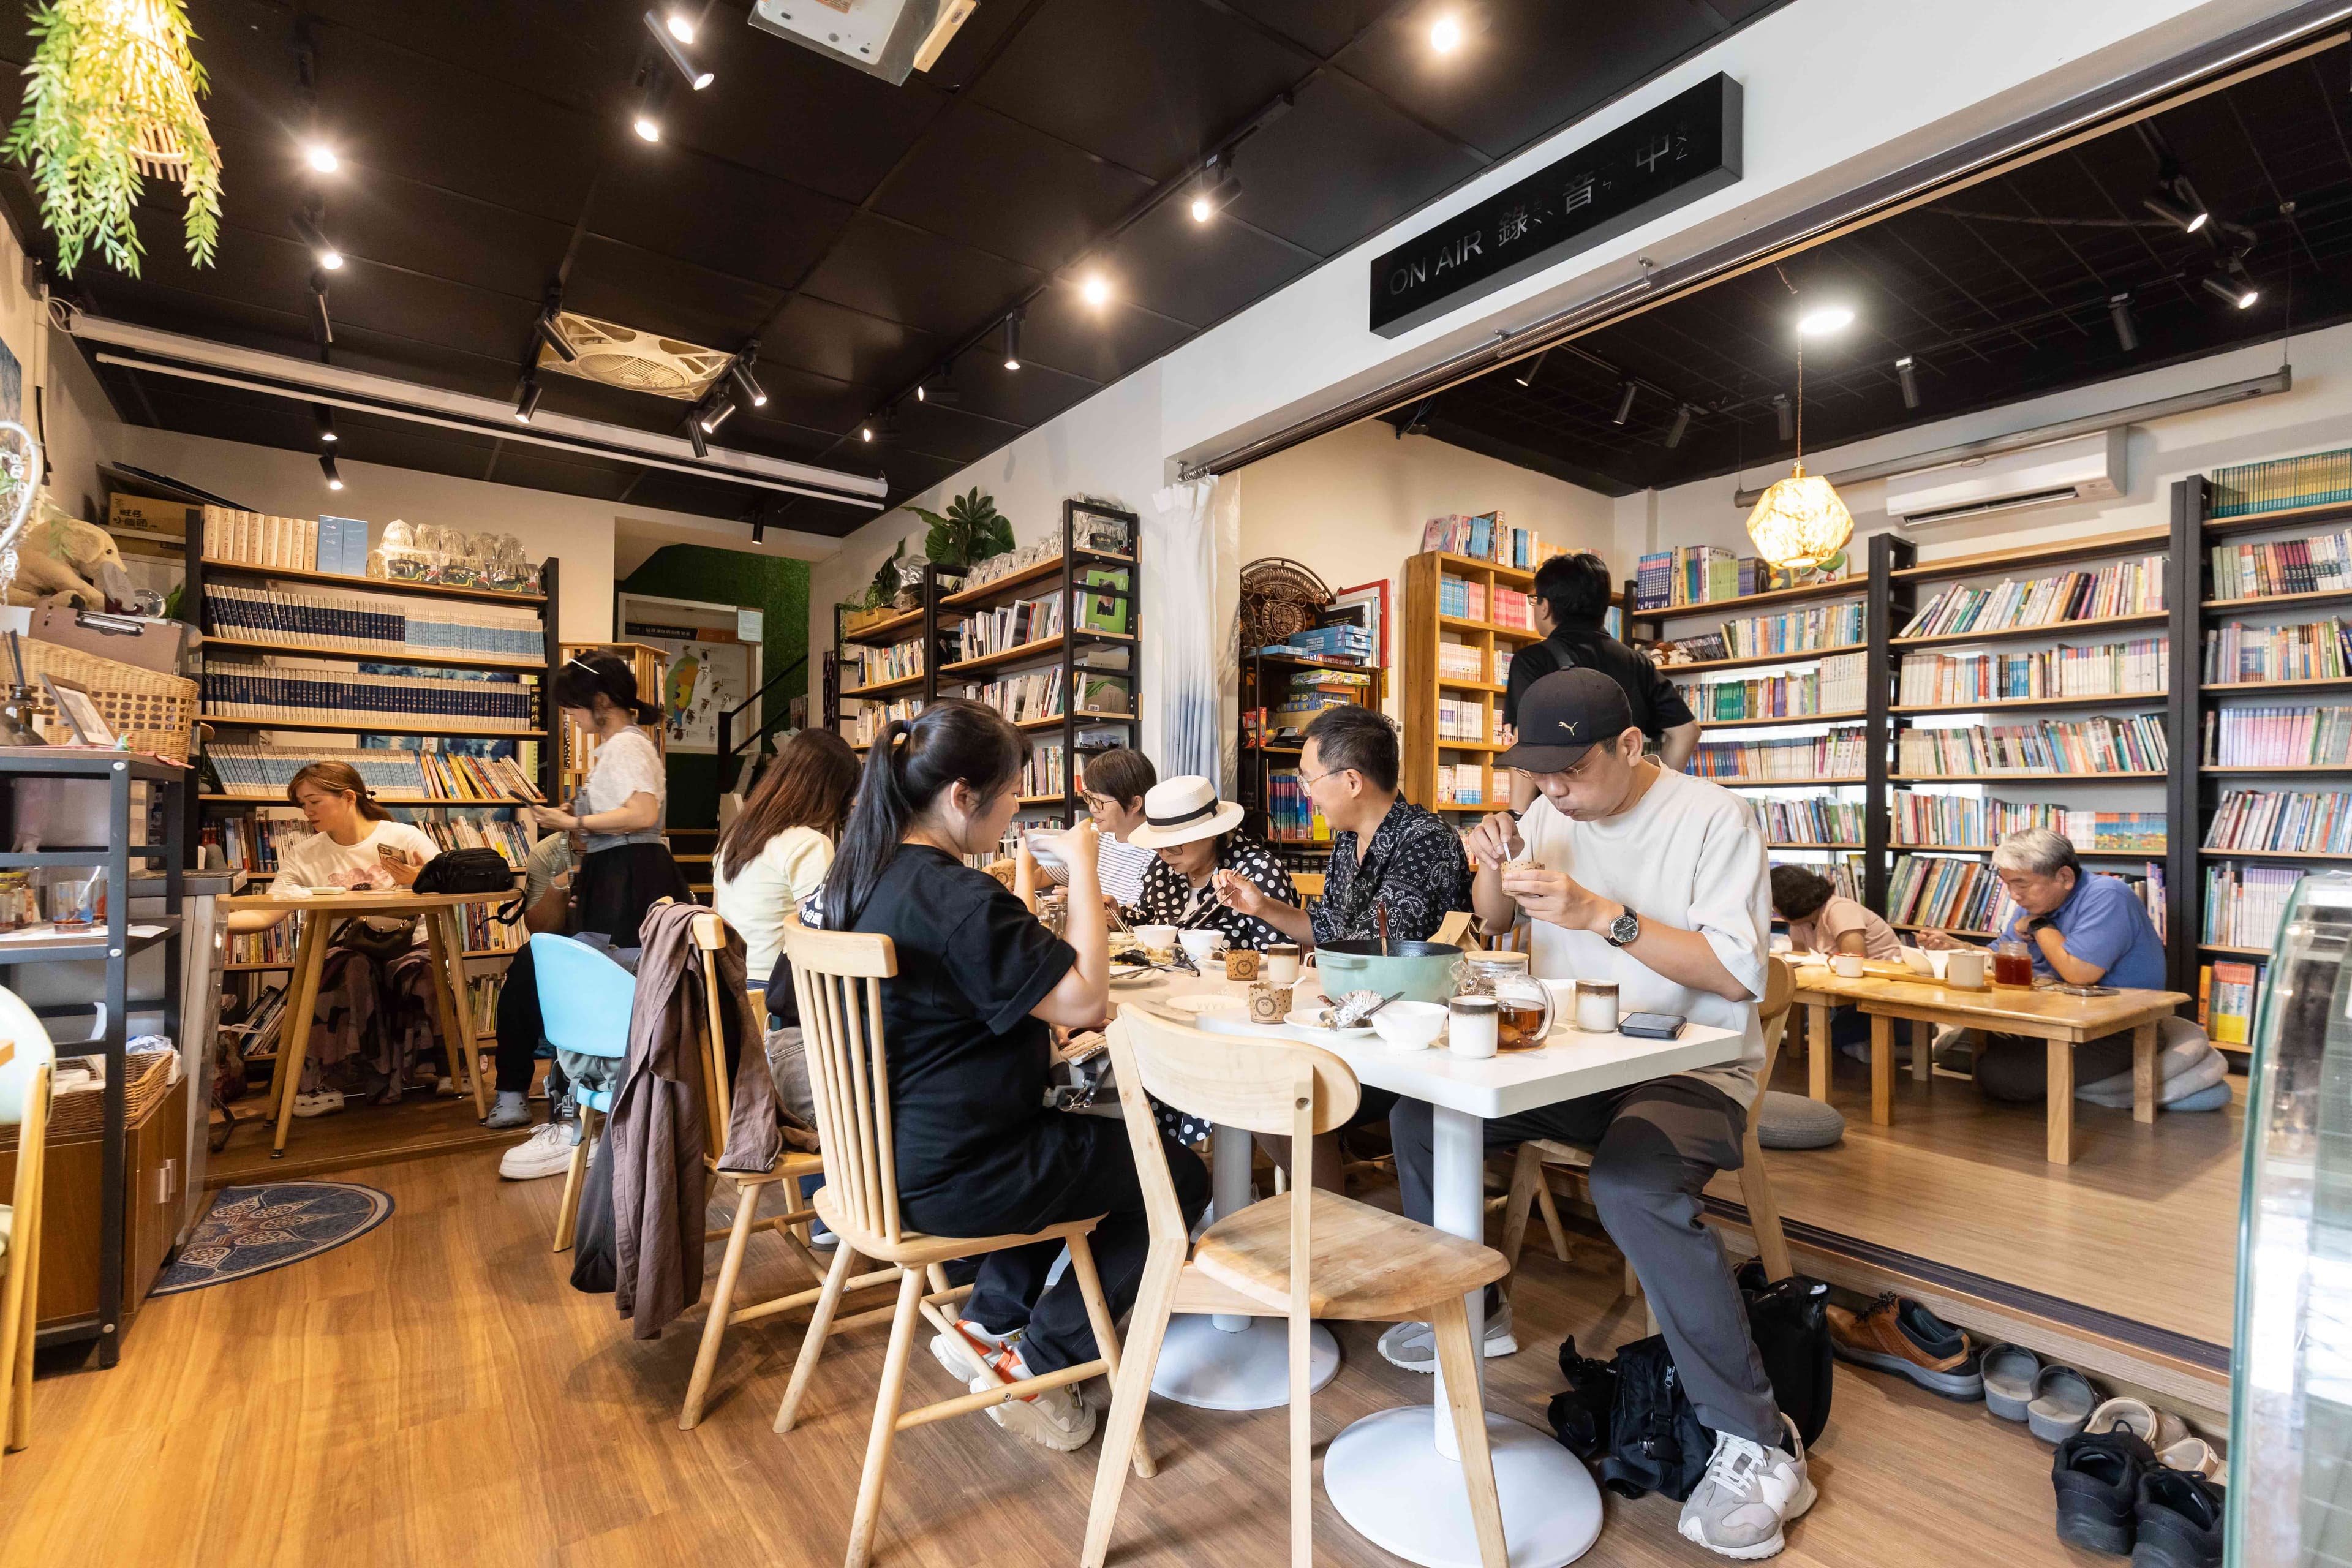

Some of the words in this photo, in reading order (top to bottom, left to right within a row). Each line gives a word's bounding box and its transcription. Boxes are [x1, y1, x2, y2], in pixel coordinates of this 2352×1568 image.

[1389, 257, 1427, 296] ON
[1435, 230, 1483, 276] AIR
[1319, 656, 1338, 665] MAGNETIC
